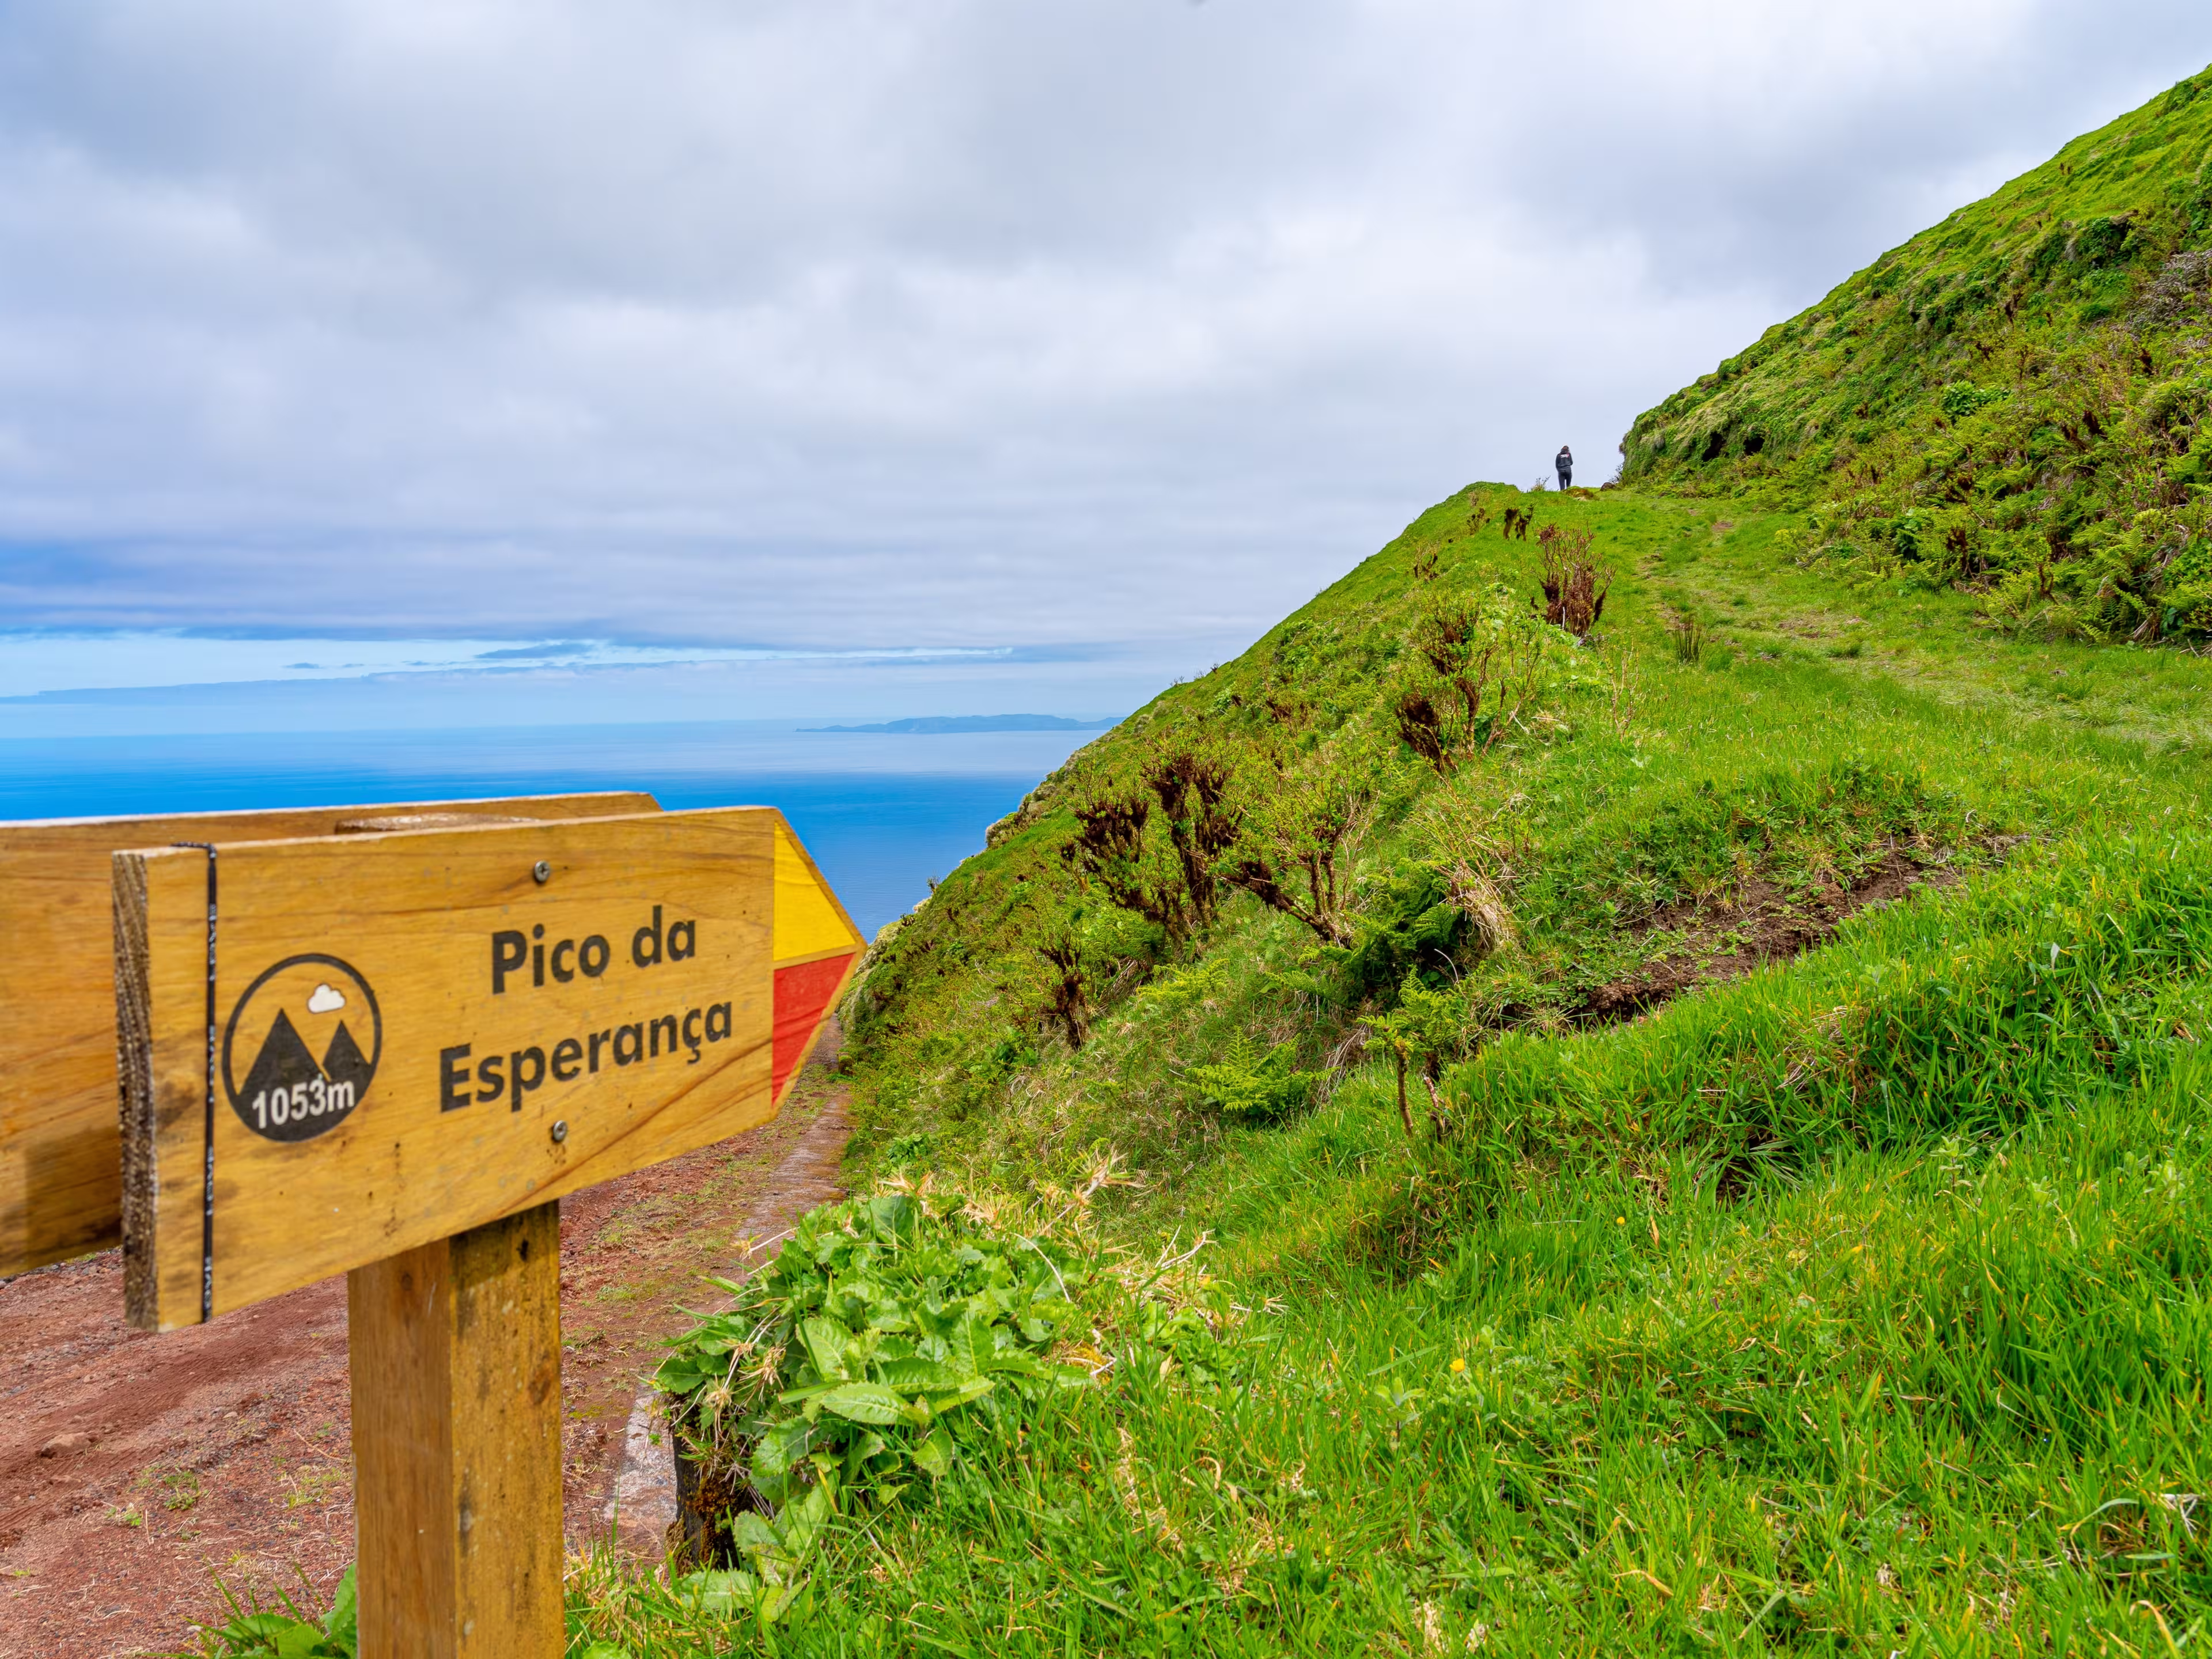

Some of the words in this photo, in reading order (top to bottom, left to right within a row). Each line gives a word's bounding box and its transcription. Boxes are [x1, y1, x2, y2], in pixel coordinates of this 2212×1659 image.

[492, 923, 610, 994] Pico
[632, 904, 696, 968] da
[440, 1002, 732, 1113] Esperança
[252, 1078, 355, 1128] 1053m
